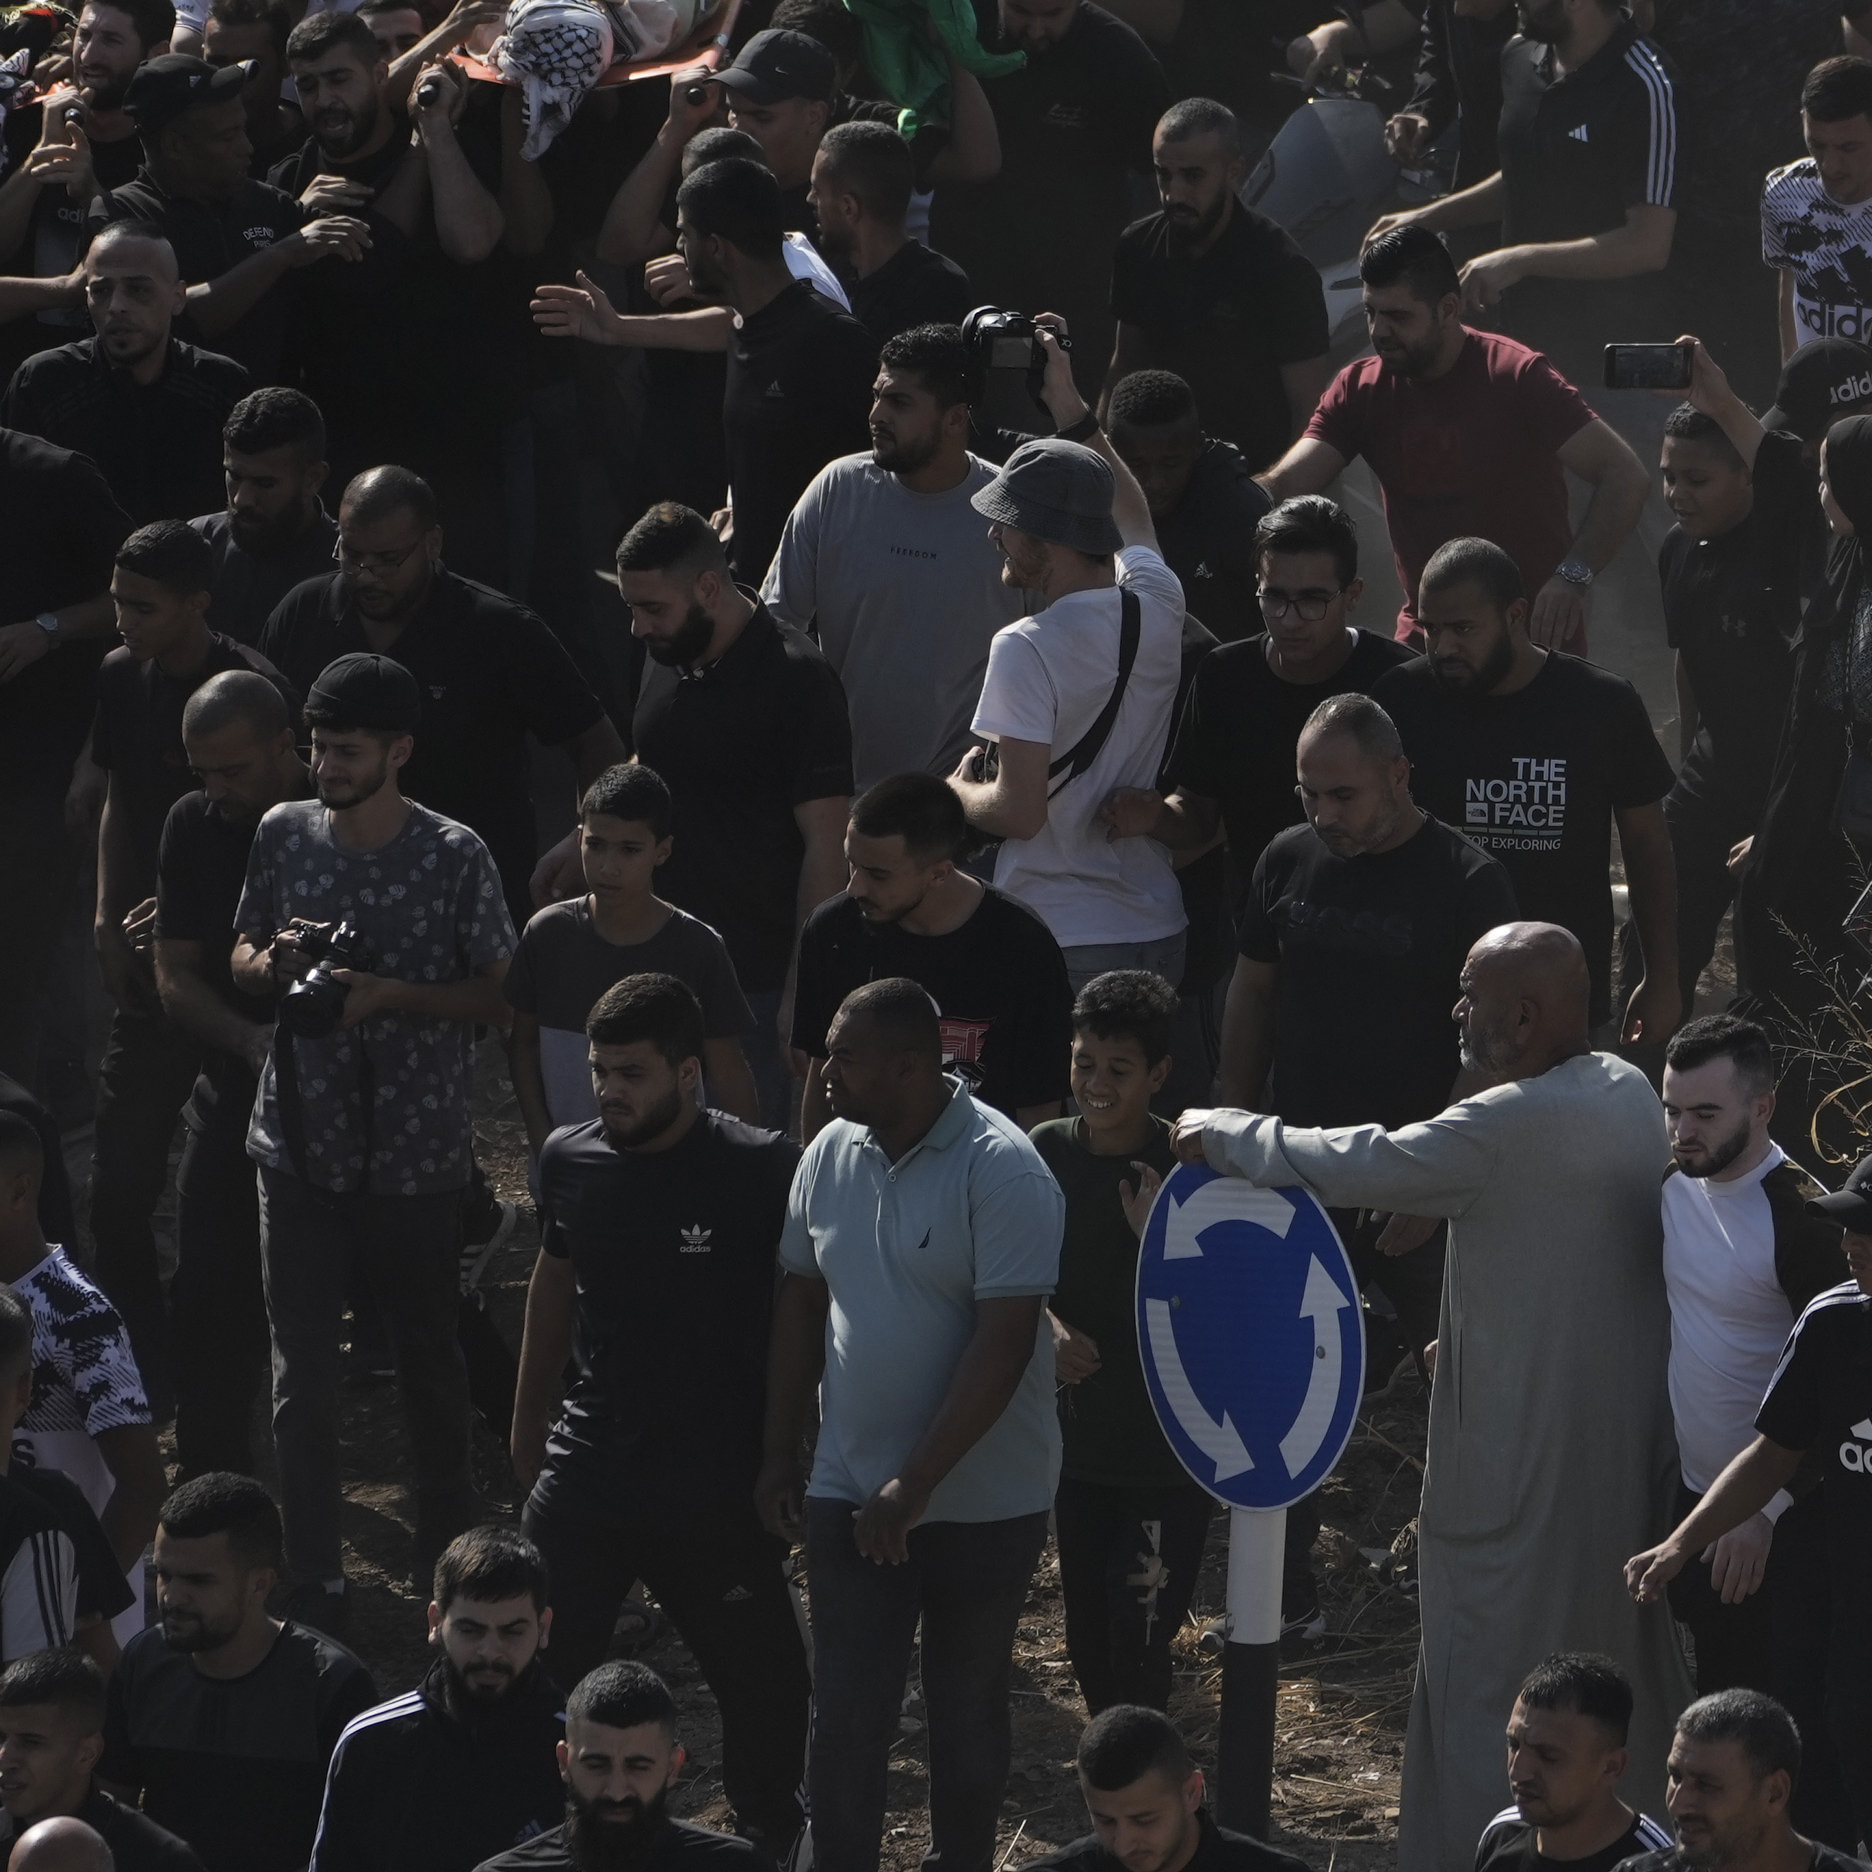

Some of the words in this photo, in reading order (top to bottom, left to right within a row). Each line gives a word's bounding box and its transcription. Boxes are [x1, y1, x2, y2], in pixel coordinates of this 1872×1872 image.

[242, 226, 275, 241] DEFEND
[1510, 756, 1566, 783] THE
[1465, 778, 1566, 808] NORTH
[1494, 803, 1565, 828] FACE
[1491, 837, 1562, 852] EXPLORING
[679, 1244, 711, 1254] adidas
